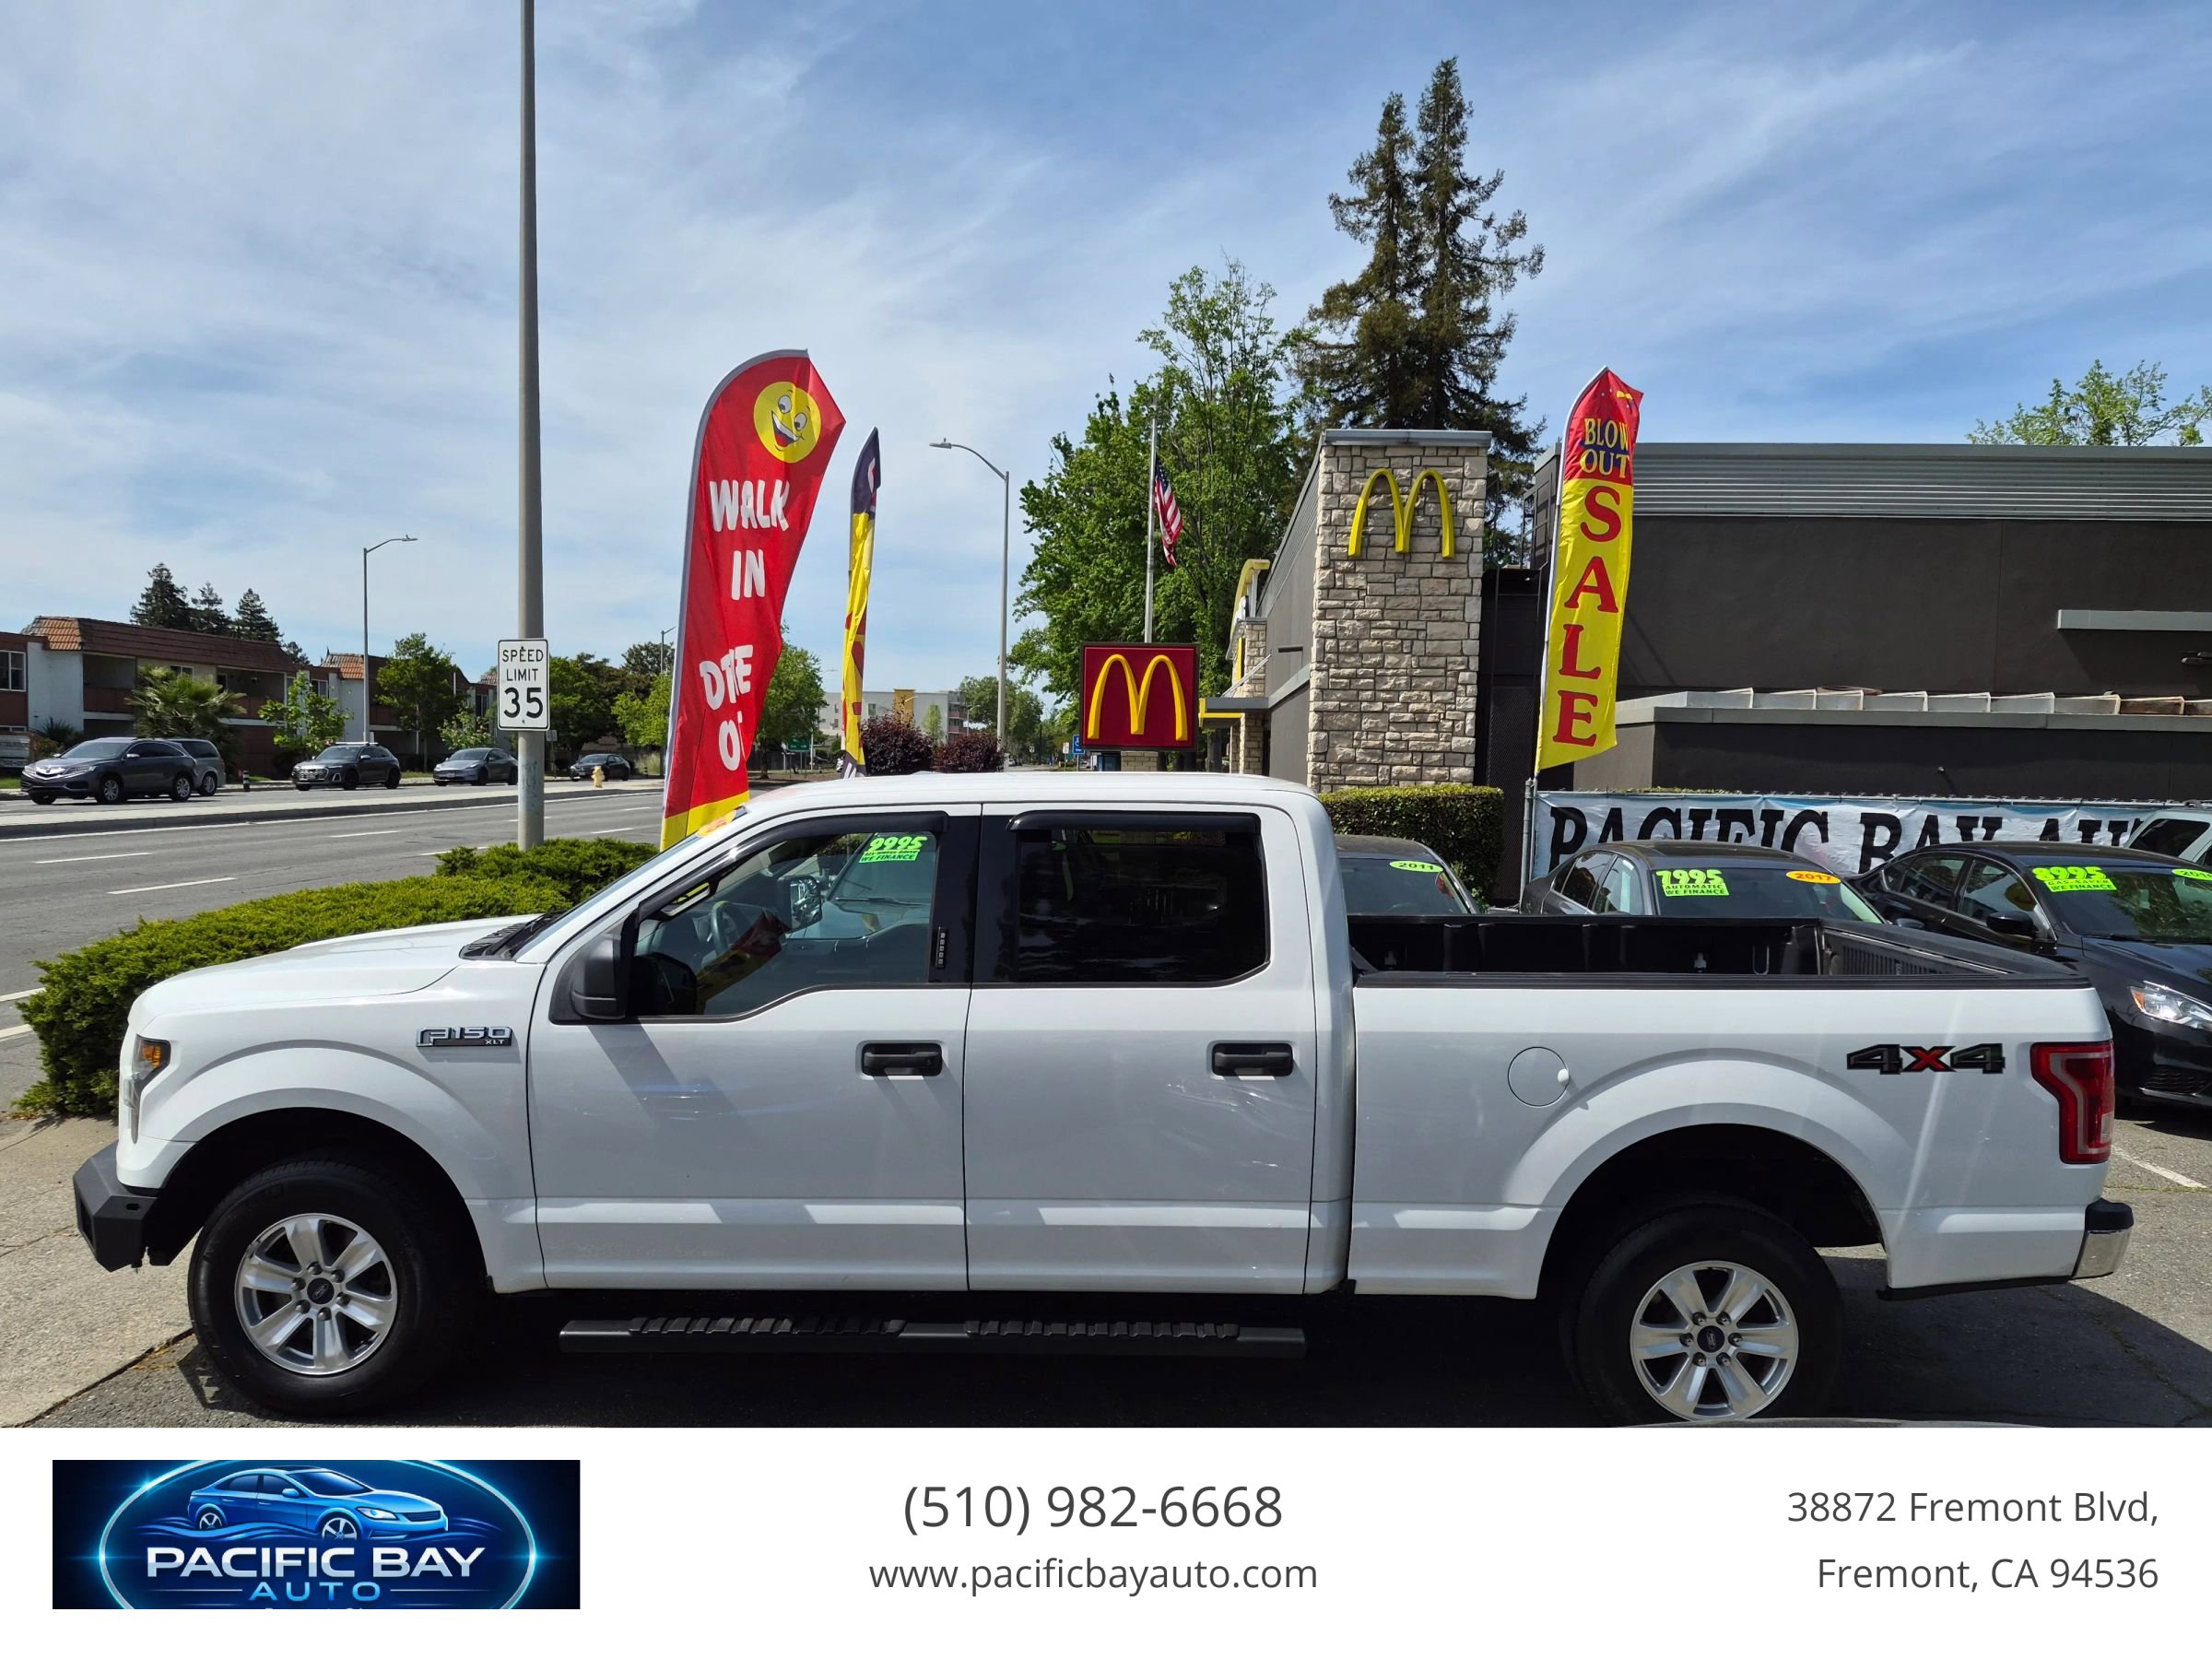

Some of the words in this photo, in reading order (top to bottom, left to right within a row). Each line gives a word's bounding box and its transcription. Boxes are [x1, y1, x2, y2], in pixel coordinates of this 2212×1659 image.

[1583, 418, 1629, 450] BLOW
[1580, 448, 1630, 478] OUT
[710, 479, 790, 532] WALK
[732, 548, 766, 601] IN
[1552, 485, 1622, 747] SALE
[502, 647, 544, 662] SPEED
[506, 668, 539, 682] LIMIT
[503, 687, 544, 719] 35
[867, 836, 928, 853] 9995
[1655, 869, 1724, 886] 7995
[1794, 873, 1832, 881] 2017
[2031, 866, 2107, 881] 8995
